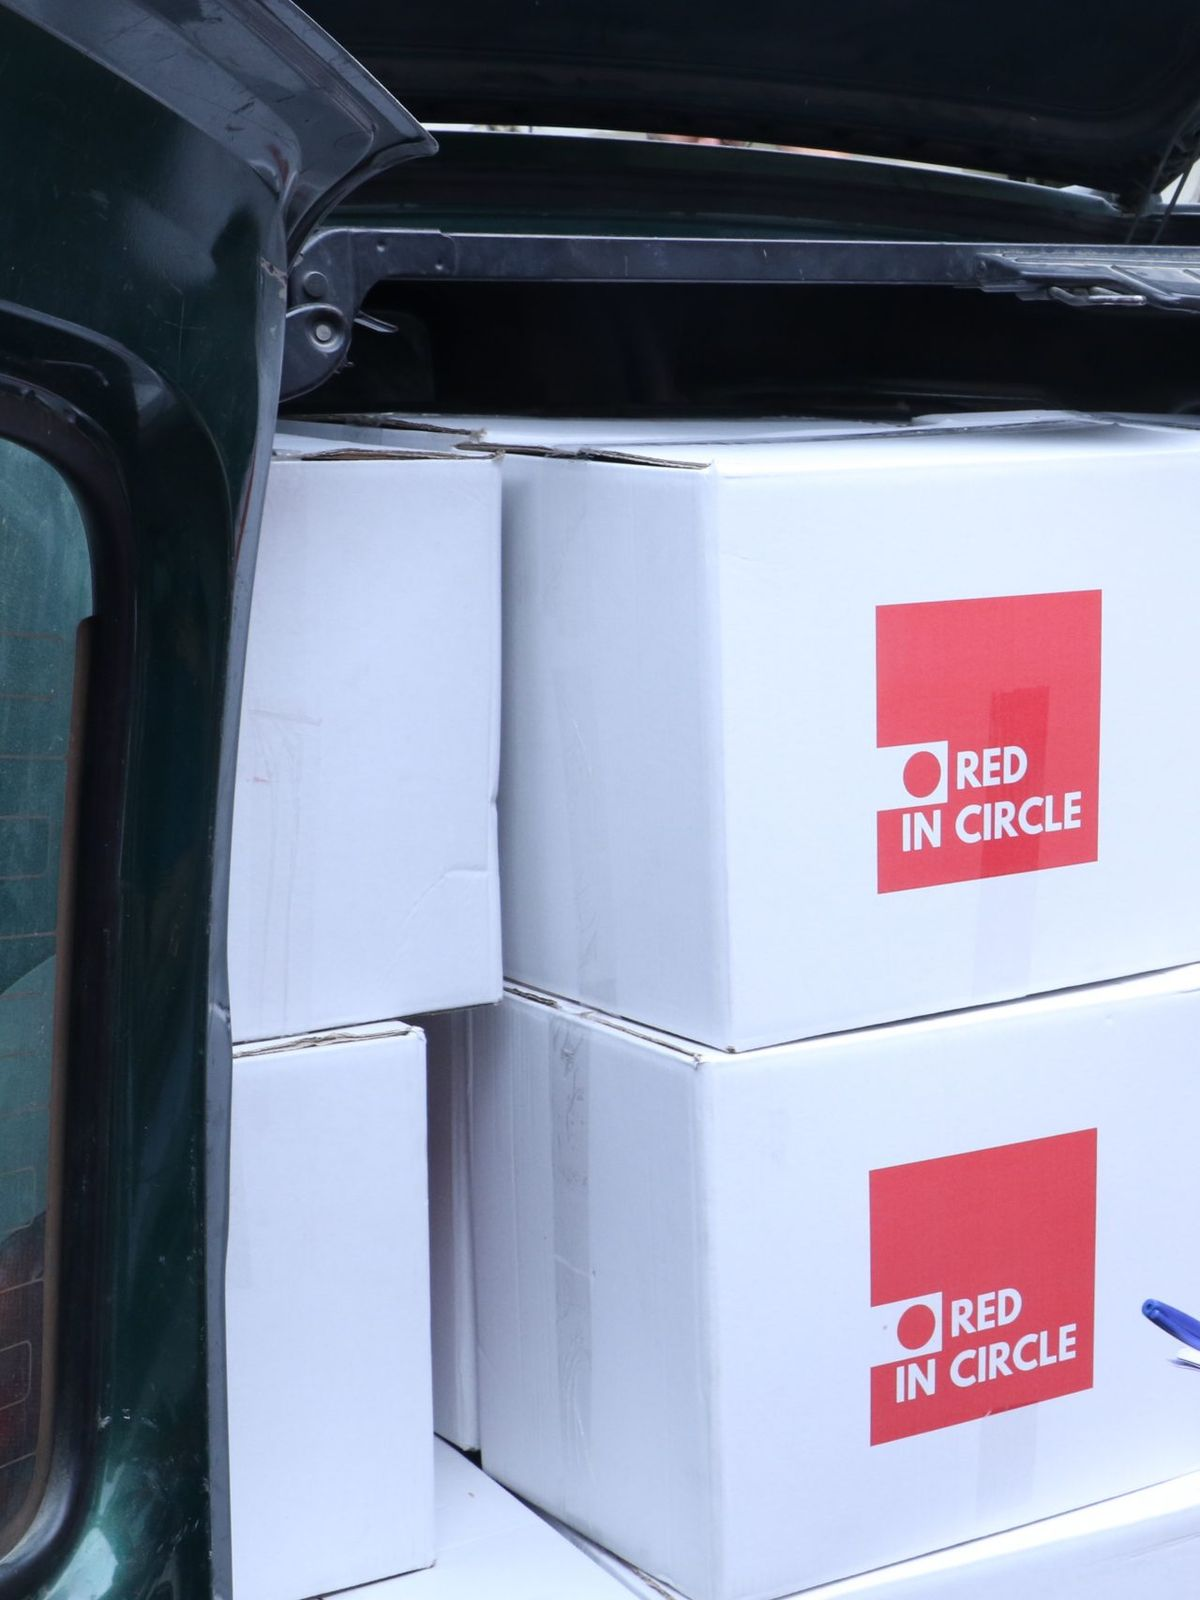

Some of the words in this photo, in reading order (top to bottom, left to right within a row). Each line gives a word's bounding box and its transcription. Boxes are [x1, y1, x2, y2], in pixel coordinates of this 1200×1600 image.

[956, 746, 1027, 790] RED
[903, 809, 941, 852] IN
[955, 791, 1082, 843] CIRCLE
[951, 1287, 1022, 1337] RED
[896, 1359, 936, 1403] IN
[949, 1323, 1077, 1388] CIRCLE
